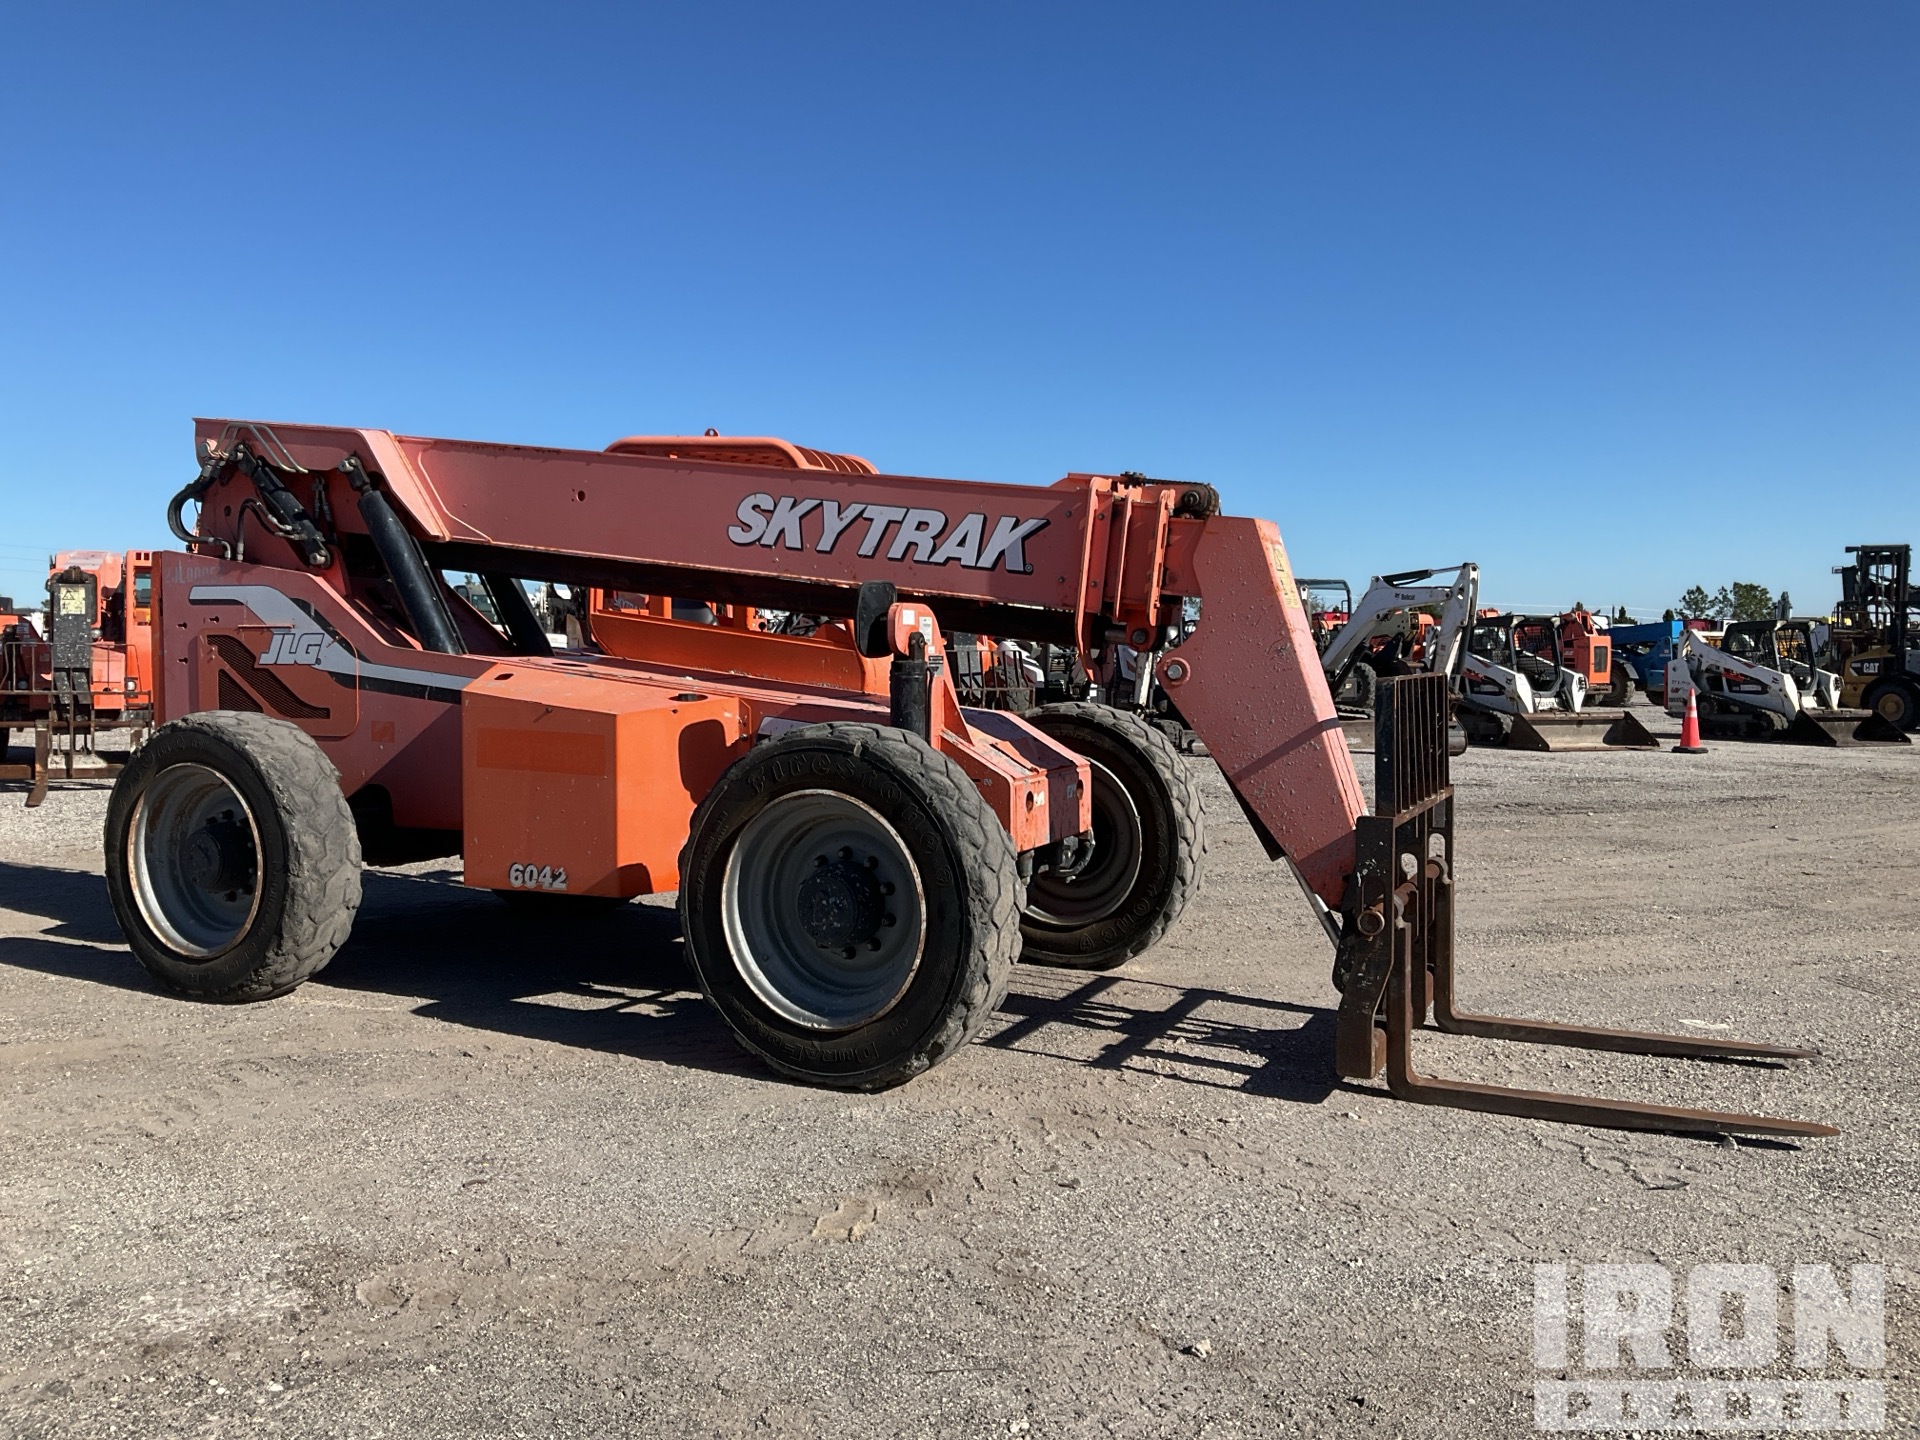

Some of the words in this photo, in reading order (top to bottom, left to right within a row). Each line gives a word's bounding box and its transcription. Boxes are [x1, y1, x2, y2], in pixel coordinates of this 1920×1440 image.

[727, 492, 1051, 574] SKYTRAK
[258, 632, 325, 665] JLG
[1863, 662, 1880, 673] CAT
[508, 862, 568, 891] 6042
